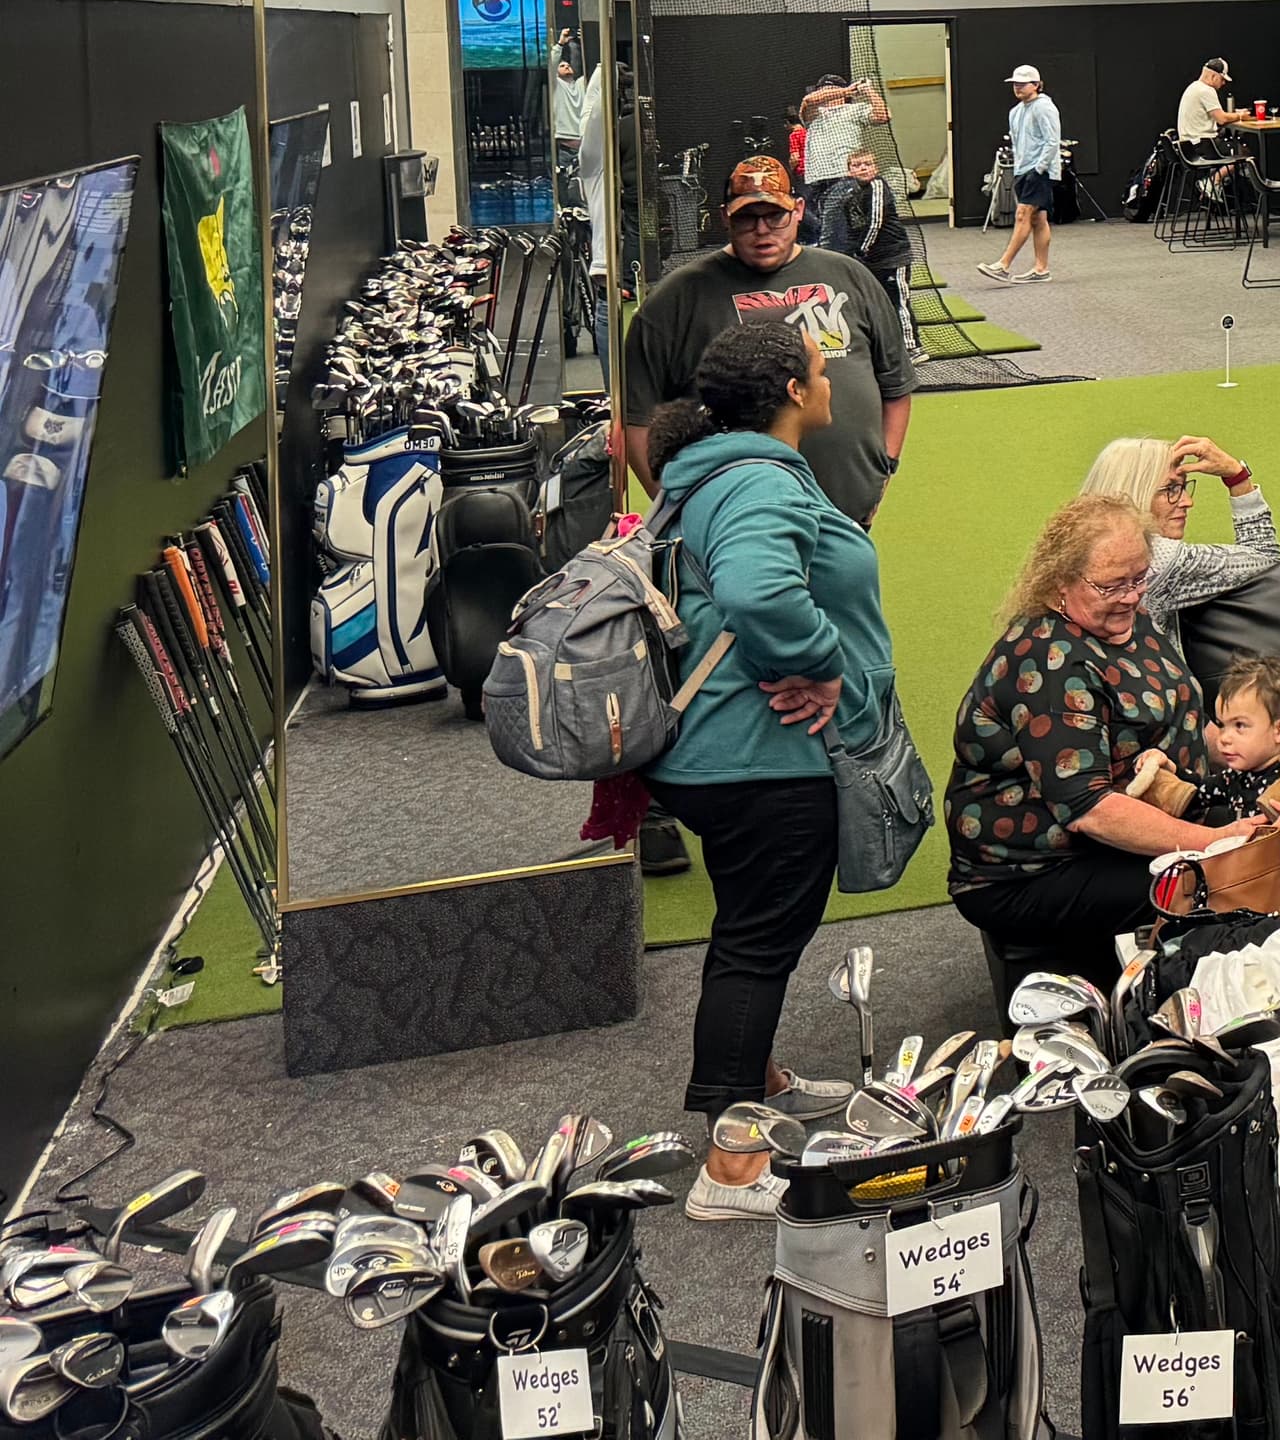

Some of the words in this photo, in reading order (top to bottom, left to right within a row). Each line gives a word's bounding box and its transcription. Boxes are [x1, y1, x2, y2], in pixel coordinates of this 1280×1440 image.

[899, 1231, 991, 1270] Wedges
[933, 1268, 966, 1297] 54°
[1133, 1351, 1221, 1377] Wedges
[512, 1365, 579, 1394] Wedges
[1162, 1385, 1196, 1408] 56°
[537, 1401, 562, 1428] 52°
